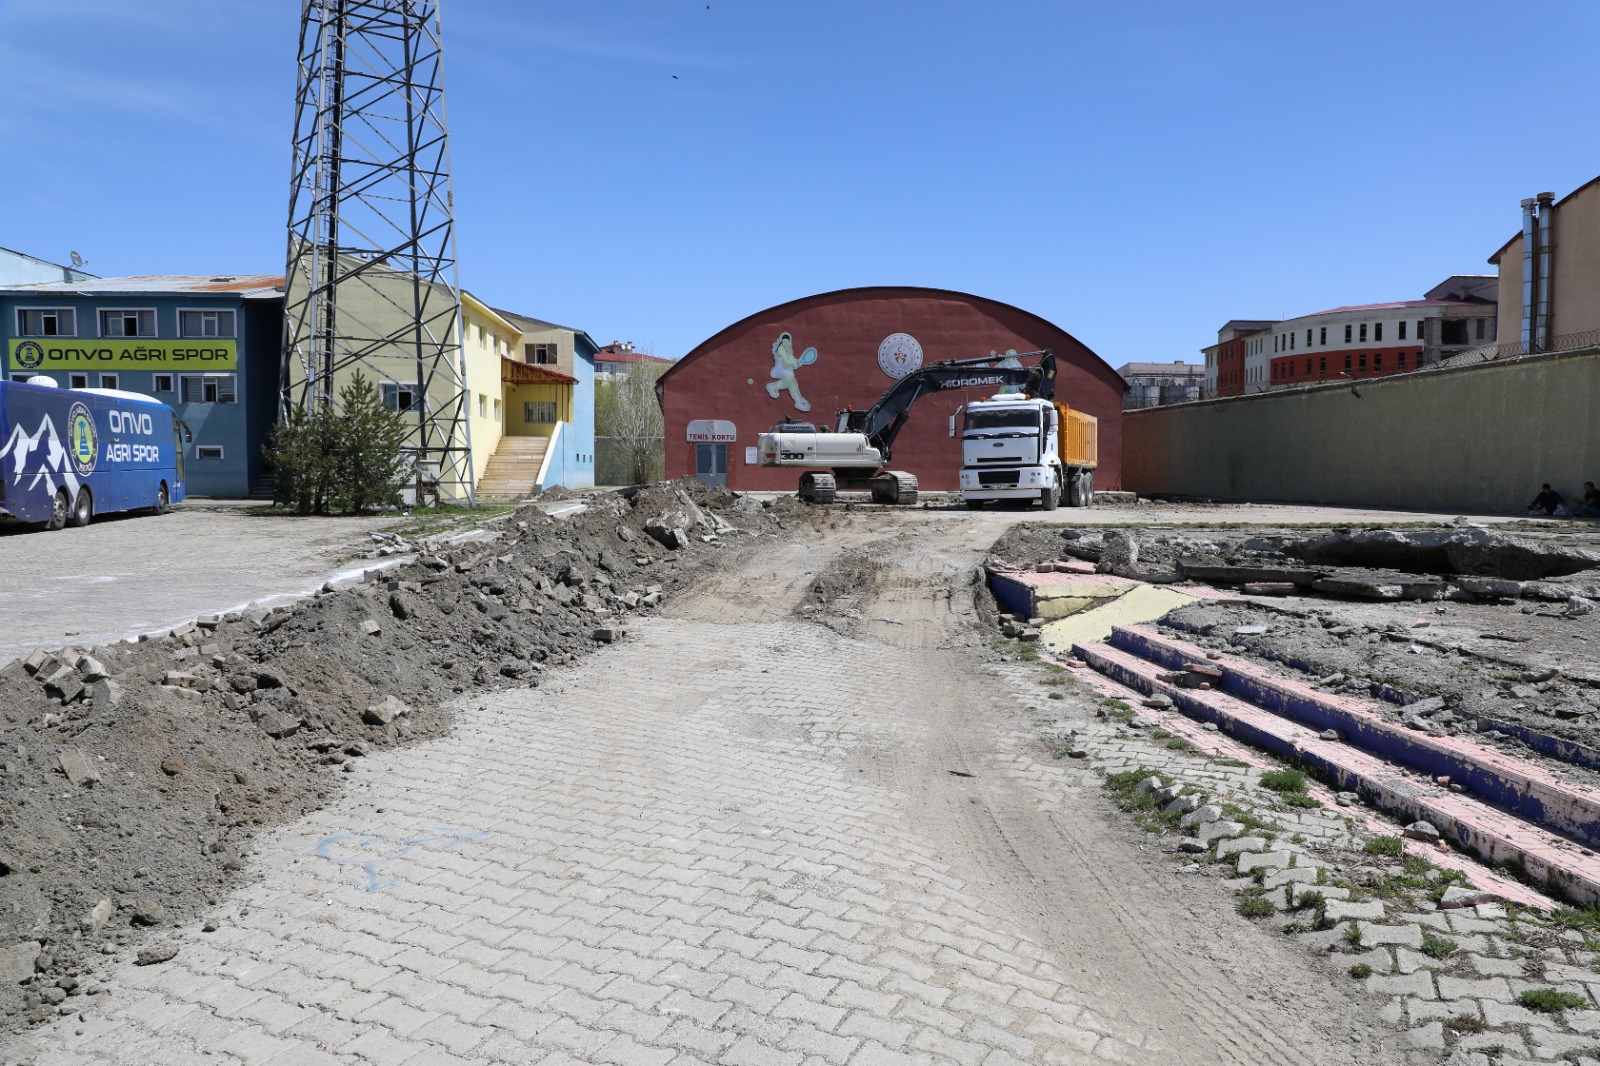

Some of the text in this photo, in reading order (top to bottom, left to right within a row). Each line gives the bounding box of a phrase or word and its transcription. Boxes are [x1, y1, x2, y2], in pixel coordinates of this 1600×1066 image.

[119, 346, 166, 361] AĞRI
[172, 349, 229, 361] SPOR
[105, 437, 160, 463] AĞRI SPOR
[780, 452, 804, 460] 300
